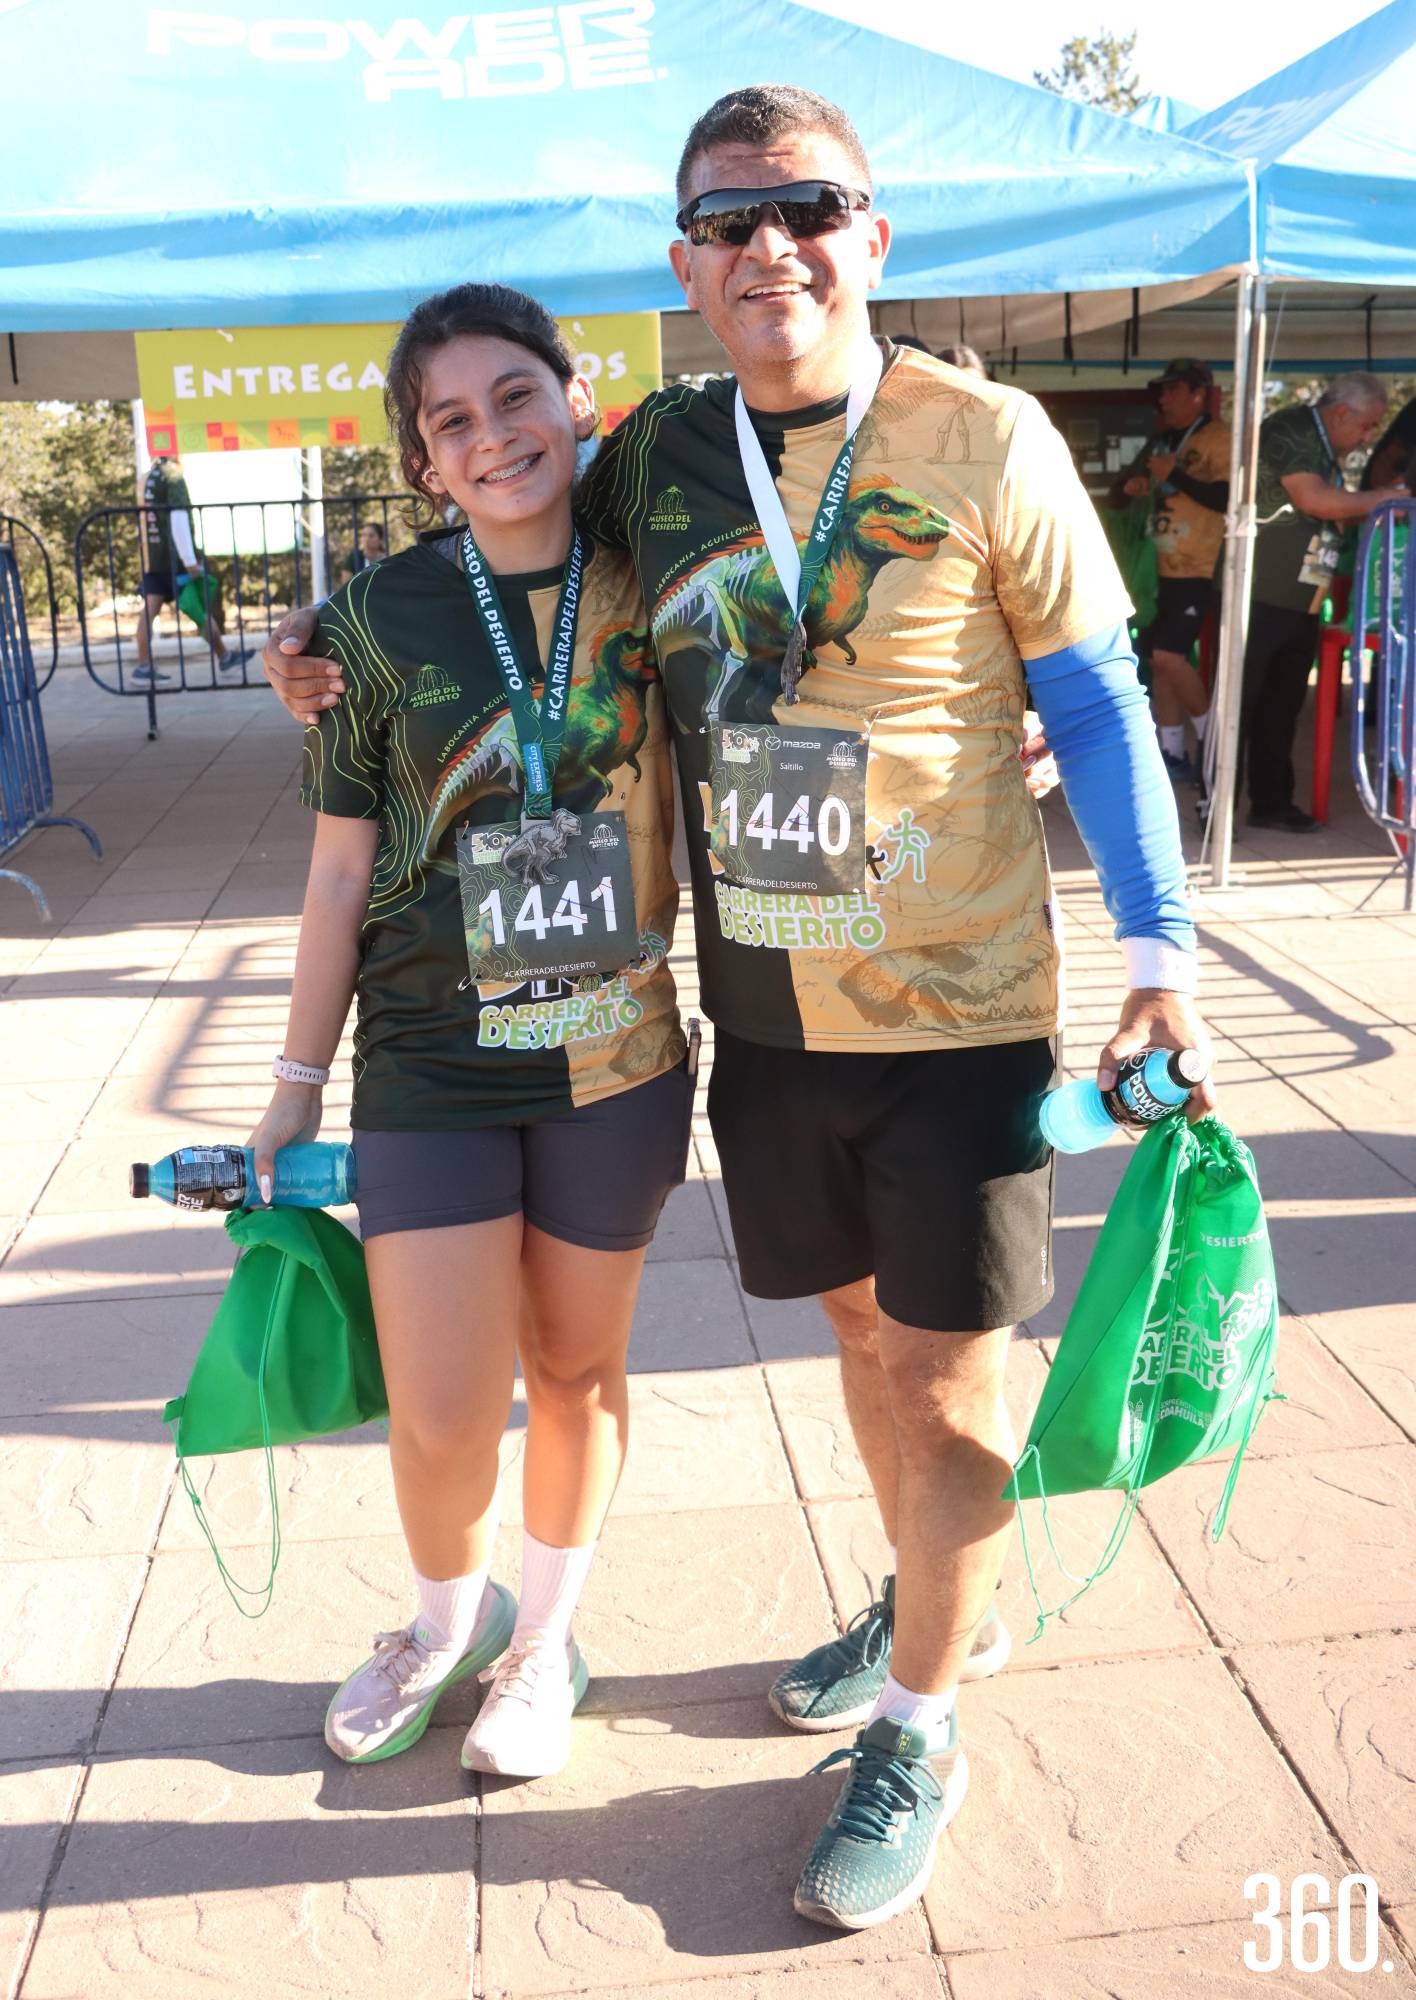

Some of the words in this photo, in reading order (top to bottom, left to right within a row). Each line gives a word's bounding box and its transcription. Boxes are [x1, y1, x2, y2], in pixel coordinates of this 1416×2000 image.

[145, 0, 659, 62] POWER
[173, 360, 387, 399] ENTREGA
[815, 431, 857, 543] #CARRER
[648, 514, 674, 523] MUSEO
[675, 514, 691, 523] DEL
[650, 522, 688, 531] DESIERTO
[655, 550, 696, 594] LABOCANIA
[700, 522, 759, 552] AGUILLONAE
[473, 575, 493, 608] DEL
[484, 609, 523, 691] DESIERTO
[547, 527, 583, 721] #CARRERADELDESIERT
[409, 688, 441, 703] MUSEO
[443, 684, 462, 694] DEL
[412, 692, 460, 709] DESIERTO
[437, 714, 480, 764] LABOCANIA
[530, 745, 538, 762] CITY
[533, 762, 543, 792] EXPRESS
[780, 761, 804, 772] Saltillo
[720, 788, 851, 856] 1440
[478, 876, 617, 945] 1441
[715, 880, 816, 914] CARRERA
[819, 894, 880, 914] DEL
[717, 905, 886, 950] DESIERTO
[504, 961, 596, 978] #CARRERADELDESIERTO
[477, 997, 644, 1050] DESIERTO
[479, 996, 598, 1024] CARRERA
